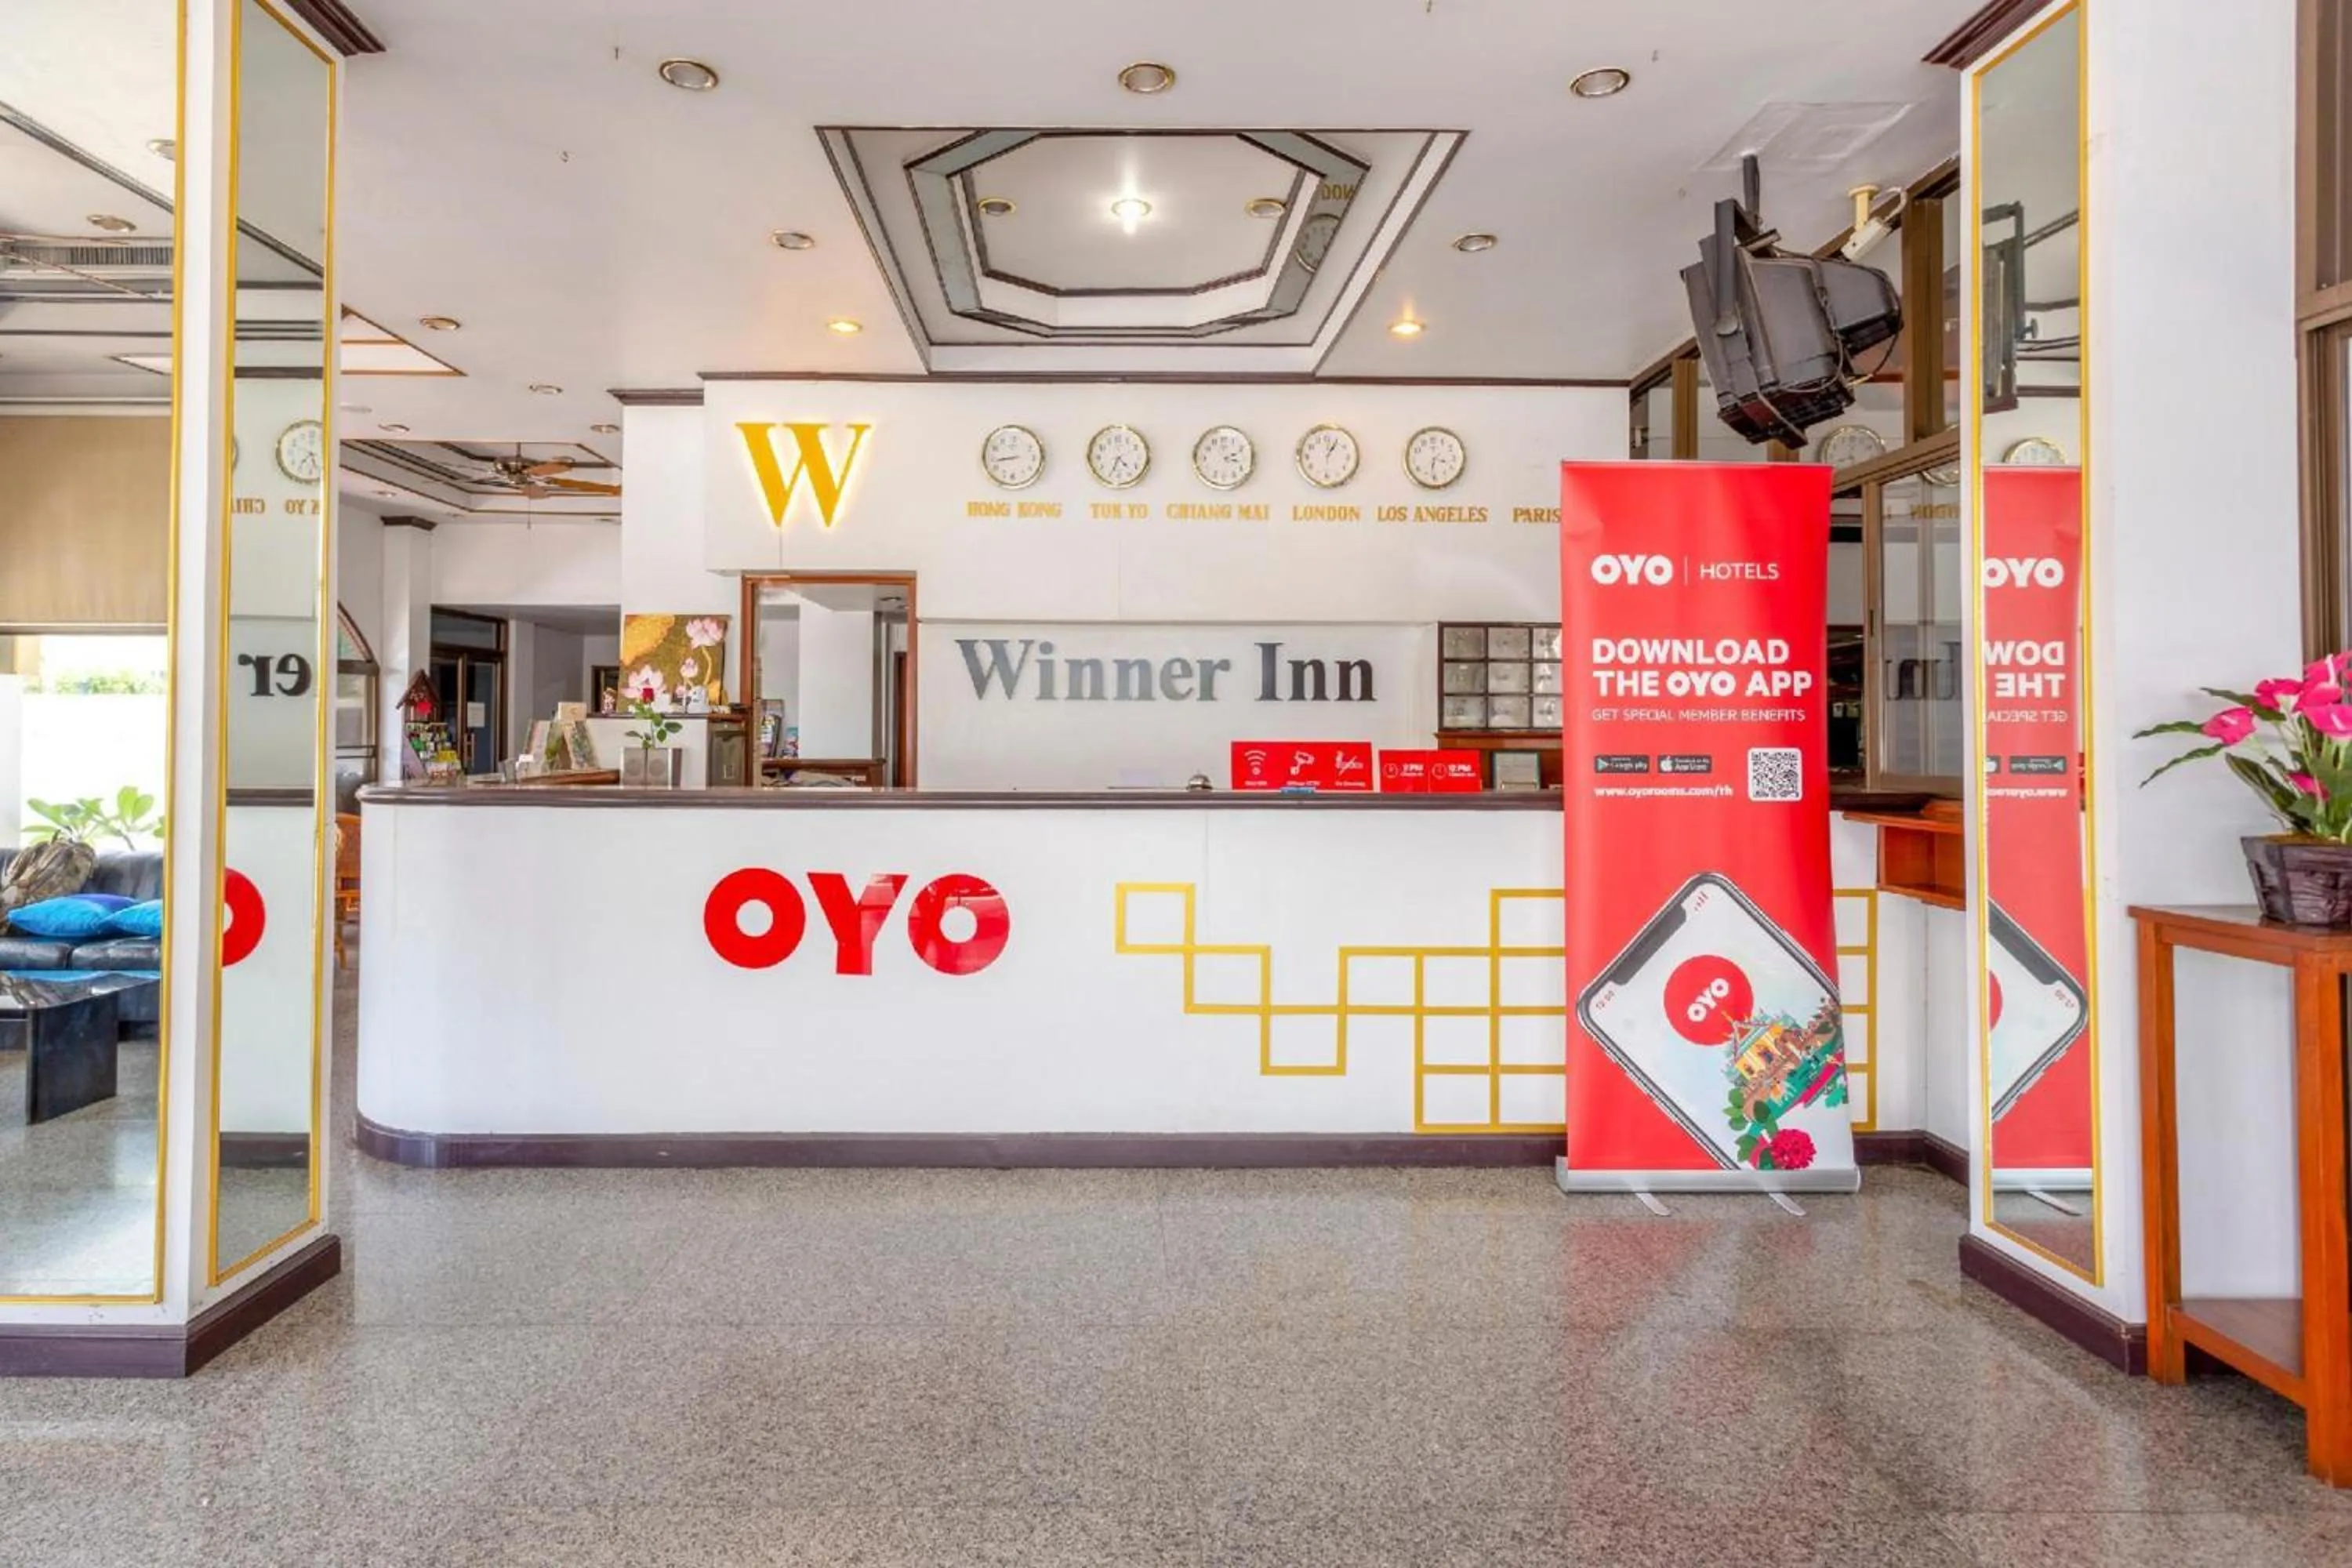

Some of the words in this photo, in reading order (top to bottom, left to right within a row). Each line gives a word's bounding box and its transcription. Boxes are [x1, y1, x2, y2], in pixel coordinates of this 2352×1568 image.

[735, 422, 871, 527] W
[967, 501, 1010, 517] HONG
[1018, 502, 1062, 518] KONG
[1166, 503, 1232, 519] CHIANG
[1238, 504, 1270, 520] MAI
[1293, 504, 1361, 521] LONDON
[1377, 506, 1407, 522] LOS
[1413, 506, 1488, 523] ANGELES
[1513, 507, 1562, 524] PARIS
[1591, 554, 1673, 586] OYO
[1700, 563, 1780, 580] HOTELS
[1592, 638, 1790, 665] DOWNLOAD
[954, 639, 1231, 701] Winner
[1254, 642, 1377, 702] Inn
[1592, 670, 1661, 697] THE
[1666, 670, 1737, 697] OYO
[1744, 670, 1812, 697] APP
[1592, 709, 1618, 721] GET
[1623, 709, 1674, 721] SPECIAL
[1679, 709, 1738, 721] MEMBER
[1741, 709, 1806, 722] BENEFITS
[703, 868, 1010, 976] OYO
[1687, 978, 1730, 1023] OYO
